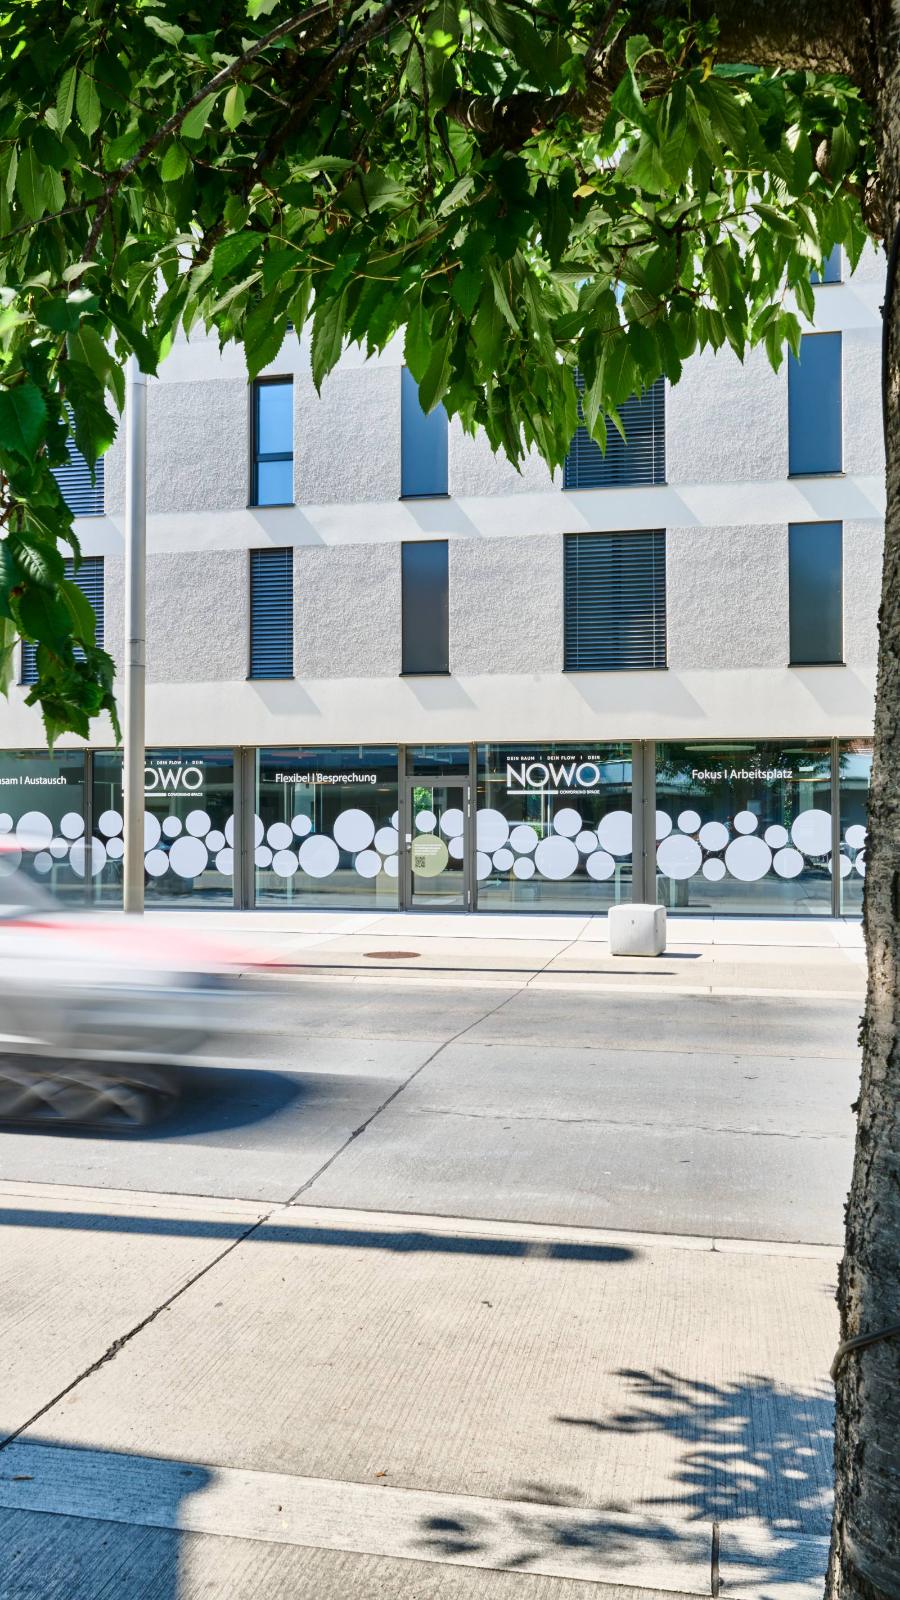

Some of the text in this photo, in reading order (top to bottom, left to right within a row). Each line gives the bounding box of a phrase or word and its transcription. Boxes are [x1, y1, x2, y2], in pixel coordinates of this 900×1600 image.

[24, 775, 67, 785] Austausch
[122, 767, 204, 790] OWO
[275, 773, 310, 783] Flexibel
[316, 772, 377, 785] Besprechung
[506, 762, 601, 788] NOWO
[692, 768, 722, 779] Fokus
[730, 768, 793, 781] Arbeitsplatz
